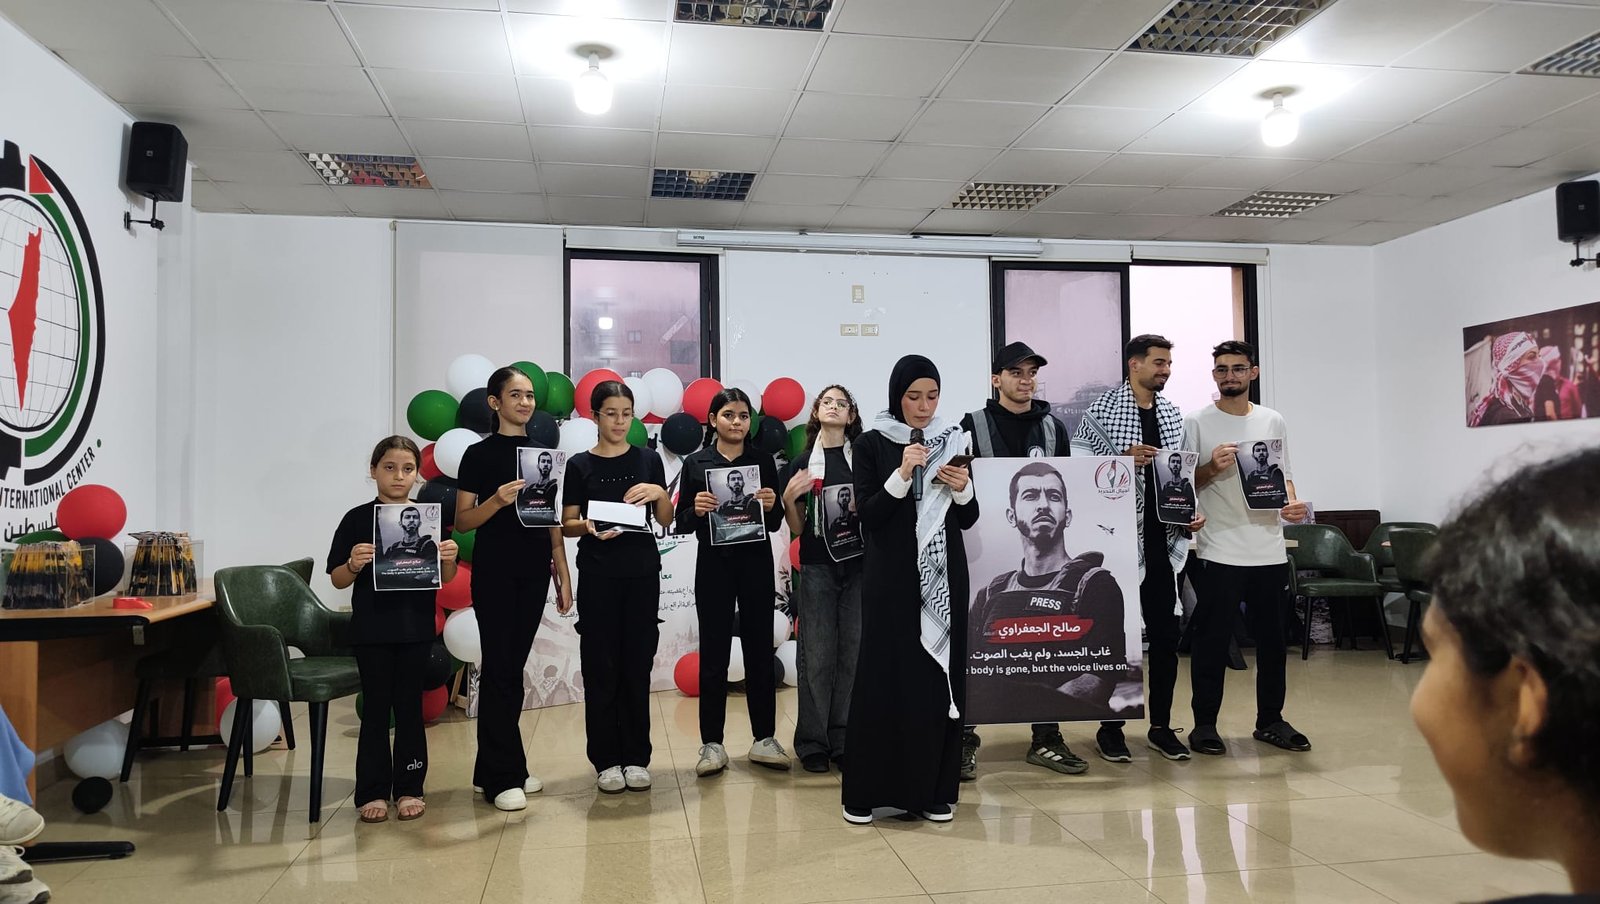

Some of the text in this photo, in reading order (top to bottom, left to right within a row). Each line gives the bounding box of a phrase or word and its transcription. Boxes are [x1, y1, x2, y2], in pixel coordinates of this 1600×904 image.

[0, 446, 96, 509] TERNATIONAL CENTER
[4, 512, 58, 543] لسطين
[1030, 596, 1062, 610] PRESS
[998, 622, 1081, 639] صالح الجعفراوي
[1009, 648, 1033, 661] يغب
[1034, 647, 1051, 661] ولم
[1090, 646, 1112, 659] غاب
[970, 665, 994, 676] body
[996, 664, 1004, 674] is
[1005, 666, 1031, 676] gone,
[1032, 664, 1048, 673] but
[1049, 663, 1065, 672] the
[1066, 662, 1091, 672] voice
[1092, 662, 1114, 671] lives
[1115, 663, 1130, 671] on.
[406, 758, 423, 770] alo
